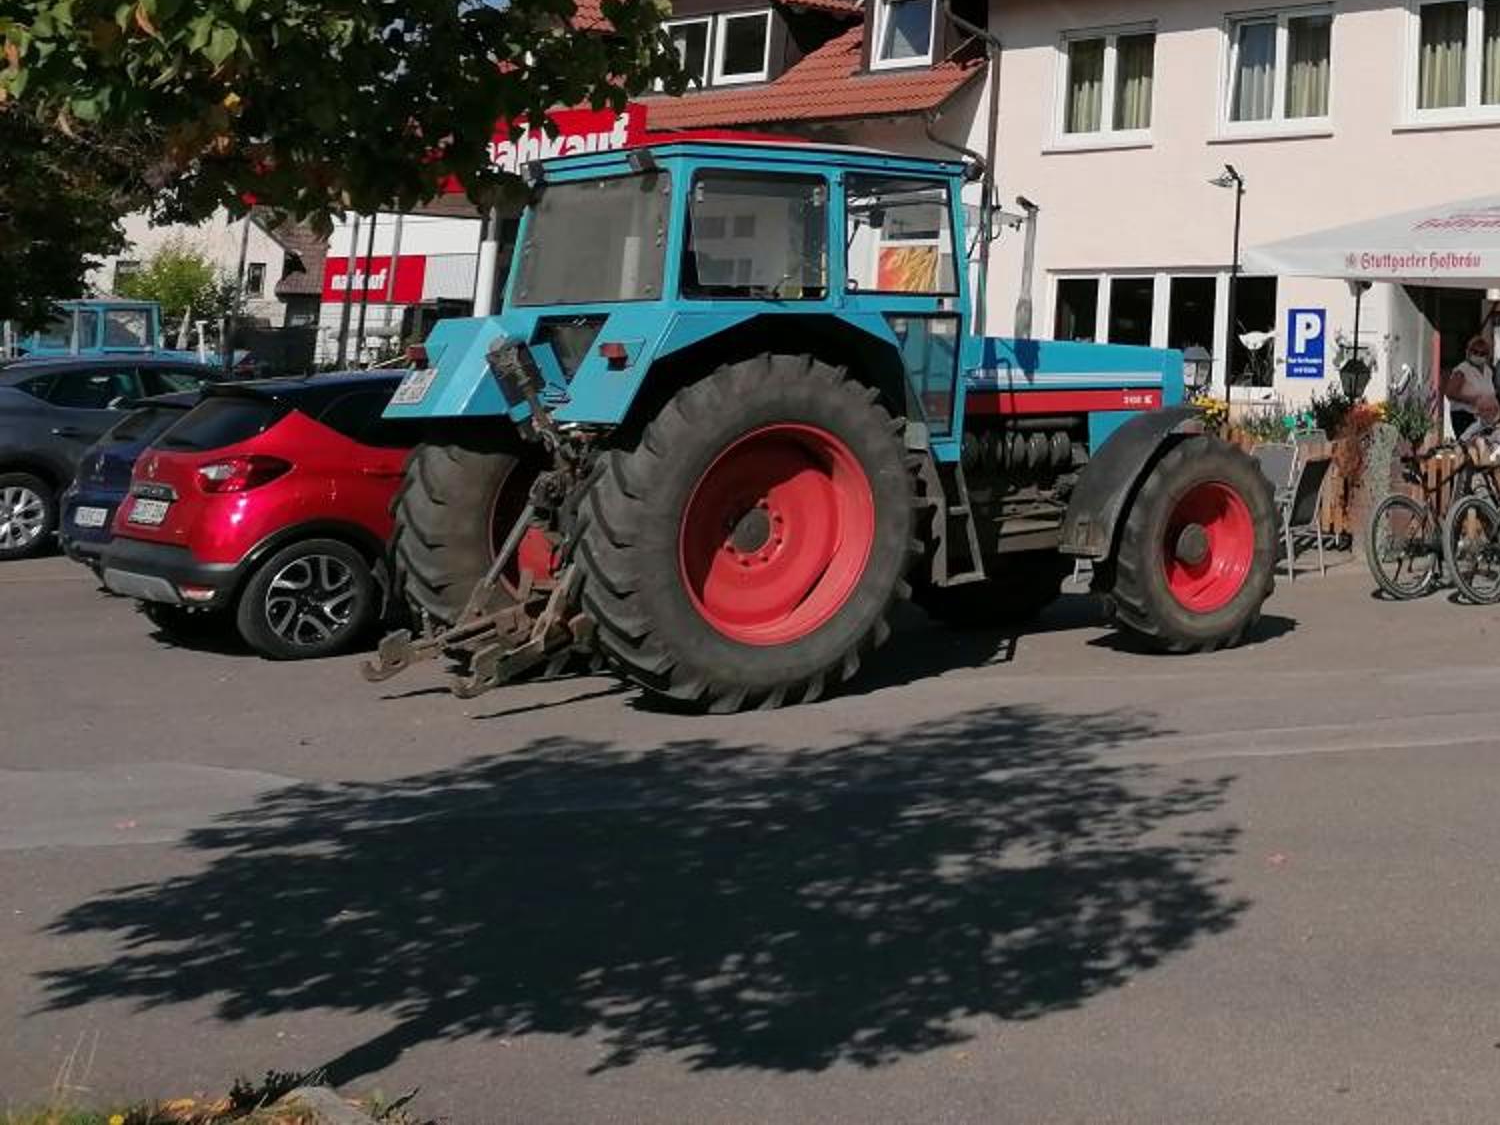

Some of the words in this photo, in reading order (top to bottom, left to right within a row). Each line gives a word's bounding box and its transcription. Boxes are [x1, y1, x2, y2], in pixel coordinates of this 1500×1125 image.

[1360, 251, 1427, 273] Stuttgarter
[1429, 251, 1481, 273] Hofbräu
[1295, 312, 1321, 354] P
